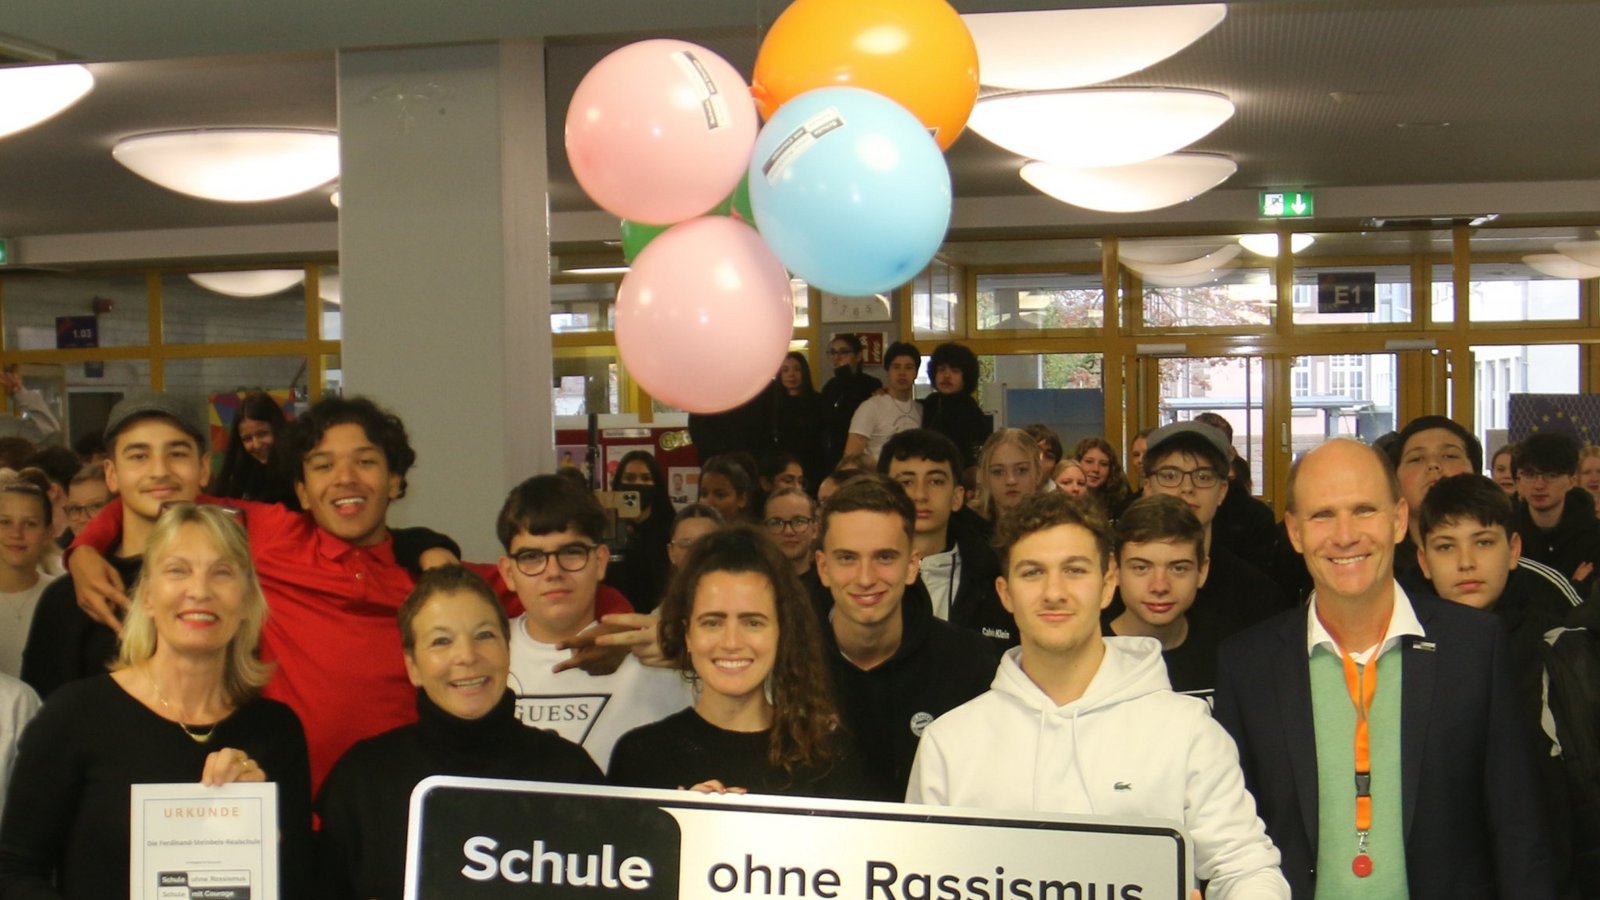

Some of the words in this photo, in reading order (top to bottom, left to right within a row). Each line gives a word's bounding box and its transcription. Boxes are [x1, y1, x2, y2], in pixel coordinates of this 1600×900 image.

[1334, 285, 1361, 305] E1
[73, 329, 91, 338] 1.03
[995, 629, 1010, 640] Klein
[164, 806, 240, 818] URKUNDE
[461, 835, 654, 891] Schule
[162, 875, 187, 884] Schule
[707, 853, 841, 899] ohne
[865, 860, 1143, 900] Rassismus
[162, 890, 187, 898] Schule
[204, 890, 235, 899] Courage
